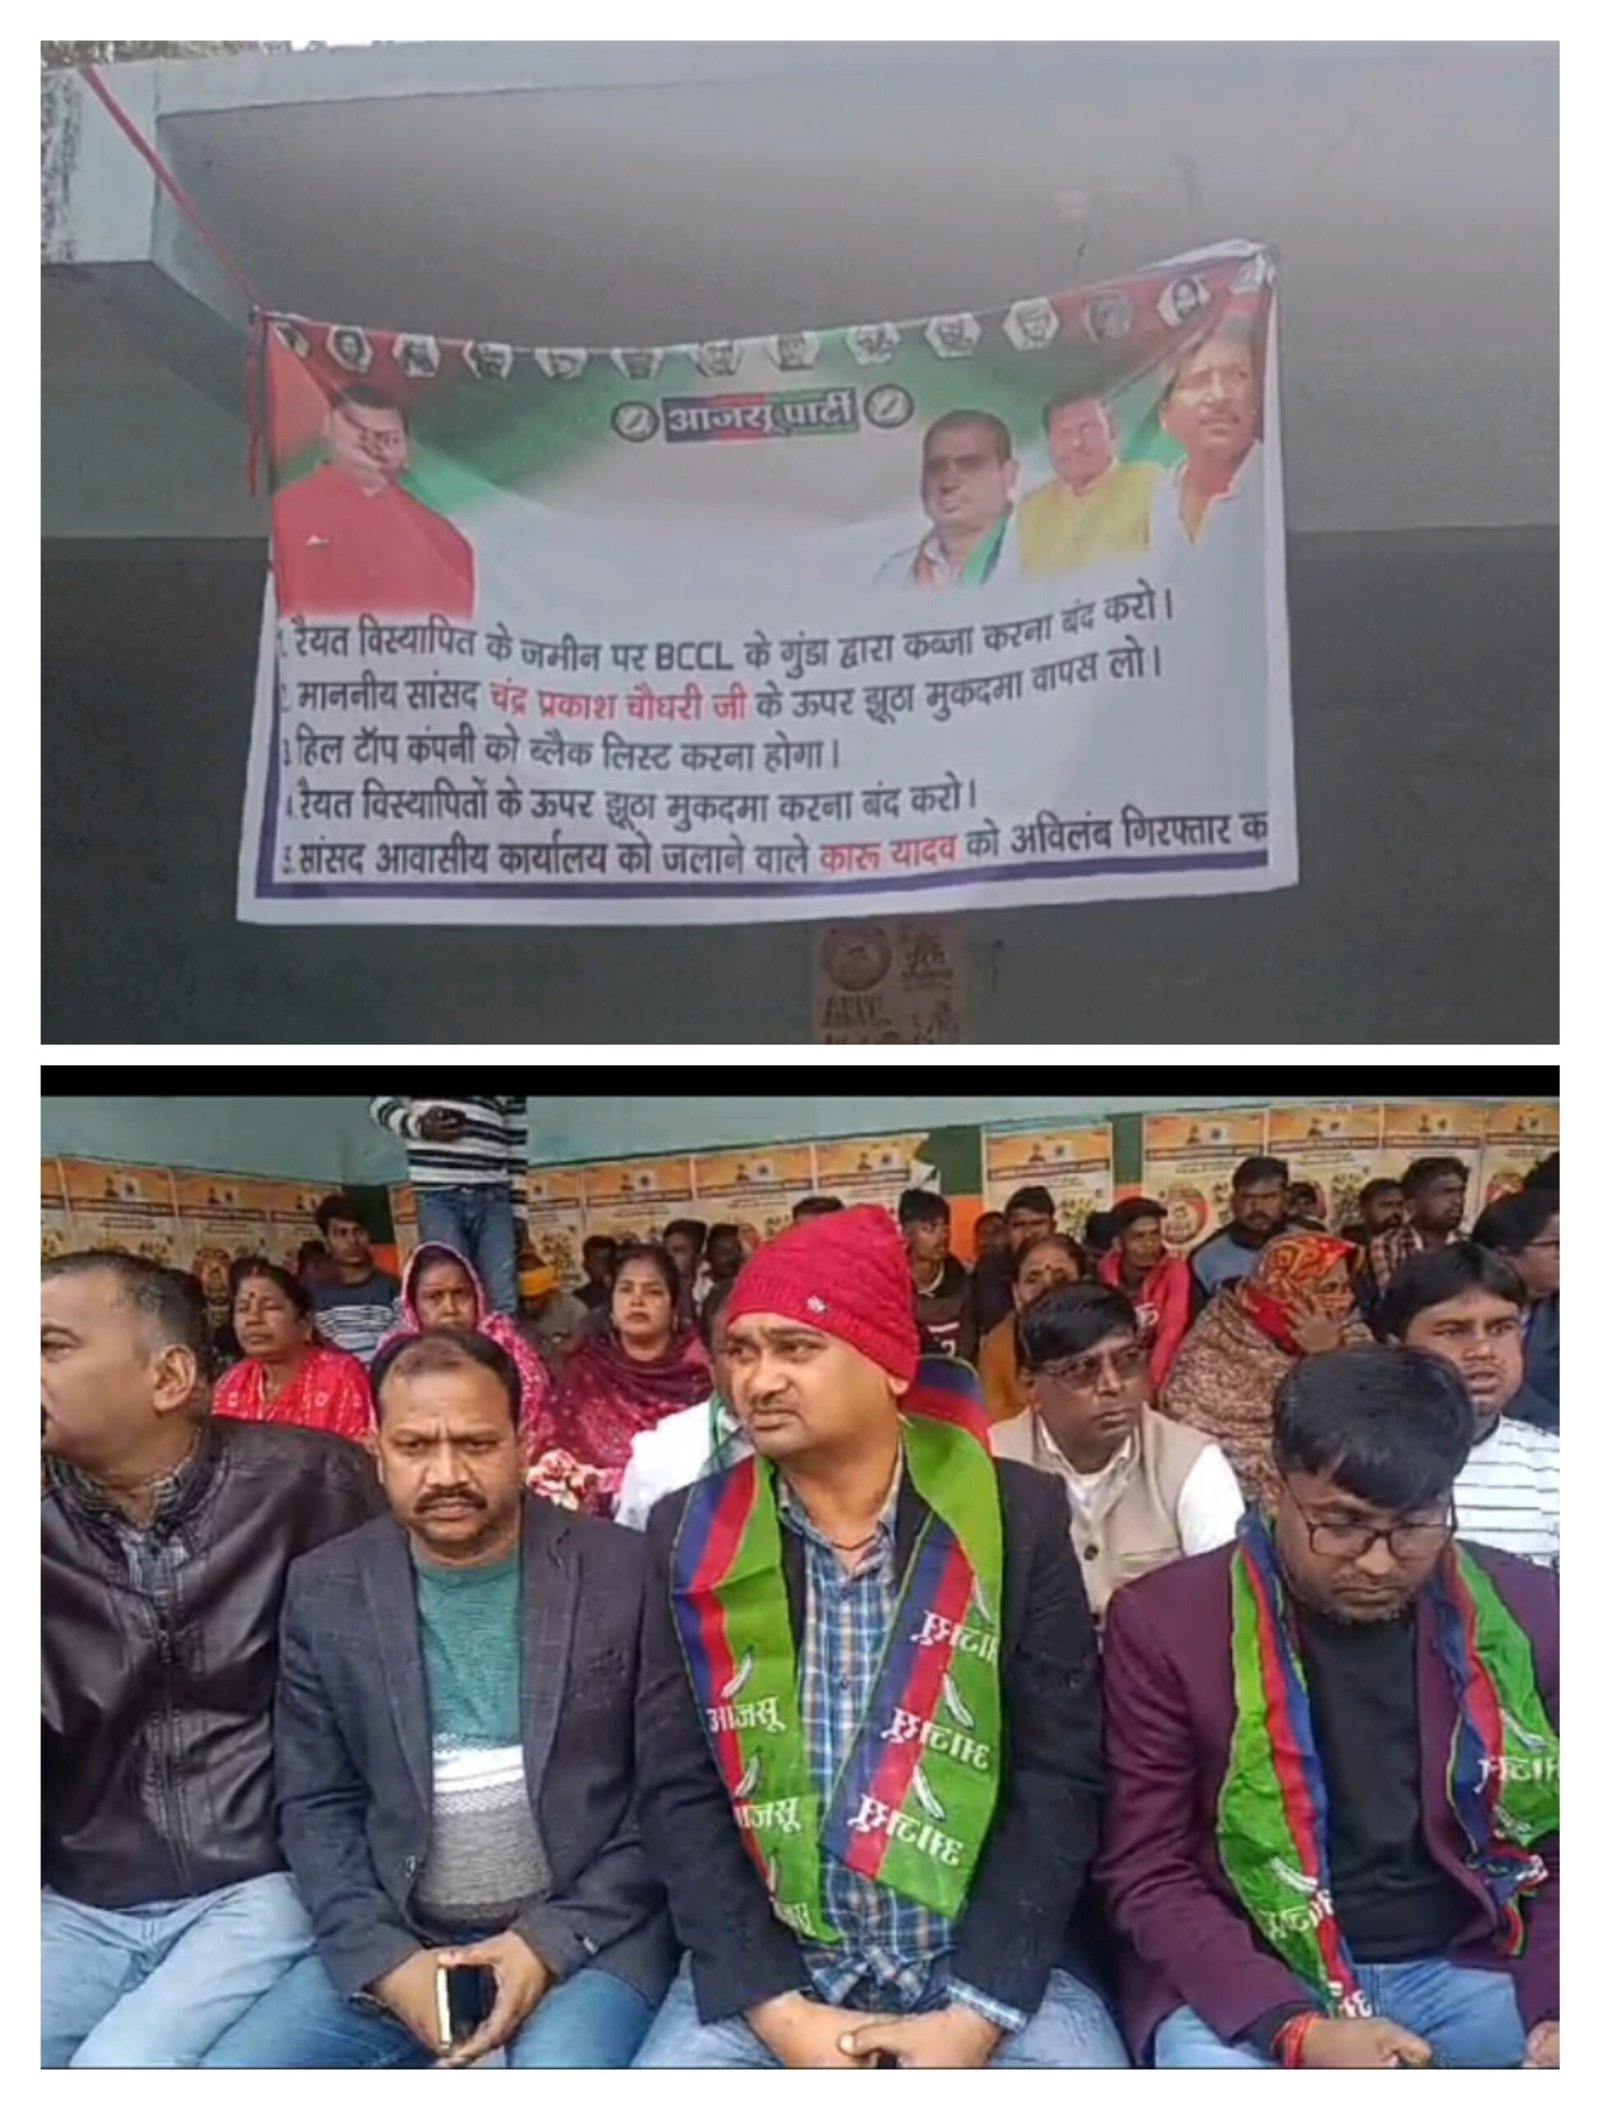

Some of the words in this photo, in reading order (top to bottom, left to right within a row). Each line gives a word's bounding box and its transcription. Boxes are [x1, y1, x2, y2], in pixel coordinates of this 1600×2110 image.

[669, 404, 790, 438] आजसू
[782, 391, 852, 427] पार्टी
[292, 613, 350, 658] रैयत
[359, 612, 478, 658] विस्थापित
[485, 621, 514, 663] के
[519, 633, 601, 673] जमीन
[611, 643, 648, 672] पर
[655, 642, 735, 672] BCCL
[744, 629, 772, 670] के
[779, 630, 830, 680] गुंडा
[837, 634, 895, 670] द्वारा
[902, 626, 975, 660] कब्जा
[982, 612, 1053, 652] करना
[1061, 599, 1095, 635] बंद
[297, 668, 399, 711] माननीय
[406, 669, 481, 711] सांसद
[488, 676, 529, 718] चंद्र
[536, 689, 615, 721] प्रकाश
[625, 680, 703, 721] चौधरी
[711, 681, 748, 720] जी
[755, 680, 784, 722] के
[790, 687, 856, 719] ऊपर
[862, 682, 916, 725] झूठा
[925, 667, 1022, 722] मुकदमा
[1032, 656, 1099, 695] वापस
[296, 722, 346, 767] हिल
[353, 725, 400, 766] टॉप
[406, 724, 476, 766] कंपनी
[485, 722, 521, 766] को
[528, 727, 595, 767] ब्लैक
[602, 730, 673, 771] लिस्ट
[680, 742, 755, 772] करना
[297, 775, 355, 820] रैयत
[362, 775, 490, 821] विस्थापितों
[497, 775, 524, 821] के
[529, 789, 597, 819] ऊपर
[603, 790, 658, 832] झूठा
[665, 794, 769, 833] मुकदमा
[778, 797, 854, 823] करना
[861, 780, 899, 819] बंद
[299, 833, 367, 876] सांसद
[375, 831, 490, 876] आवासीय
[498, 827, 609, 875] कार्यालय
[615, 830, 652, 874] को
[661, 833, 747, 875] जलाने
[754, 833, 810, 874] वाले
[889, 834, 959, 868] यादव
[965, 817, 1001, 858] को
[1010, 809, 1114, 854] अविलंब
[1120, 802, 1232, 848] गिरफ्तार
[706, 1696, 788, 1733] आजसू
